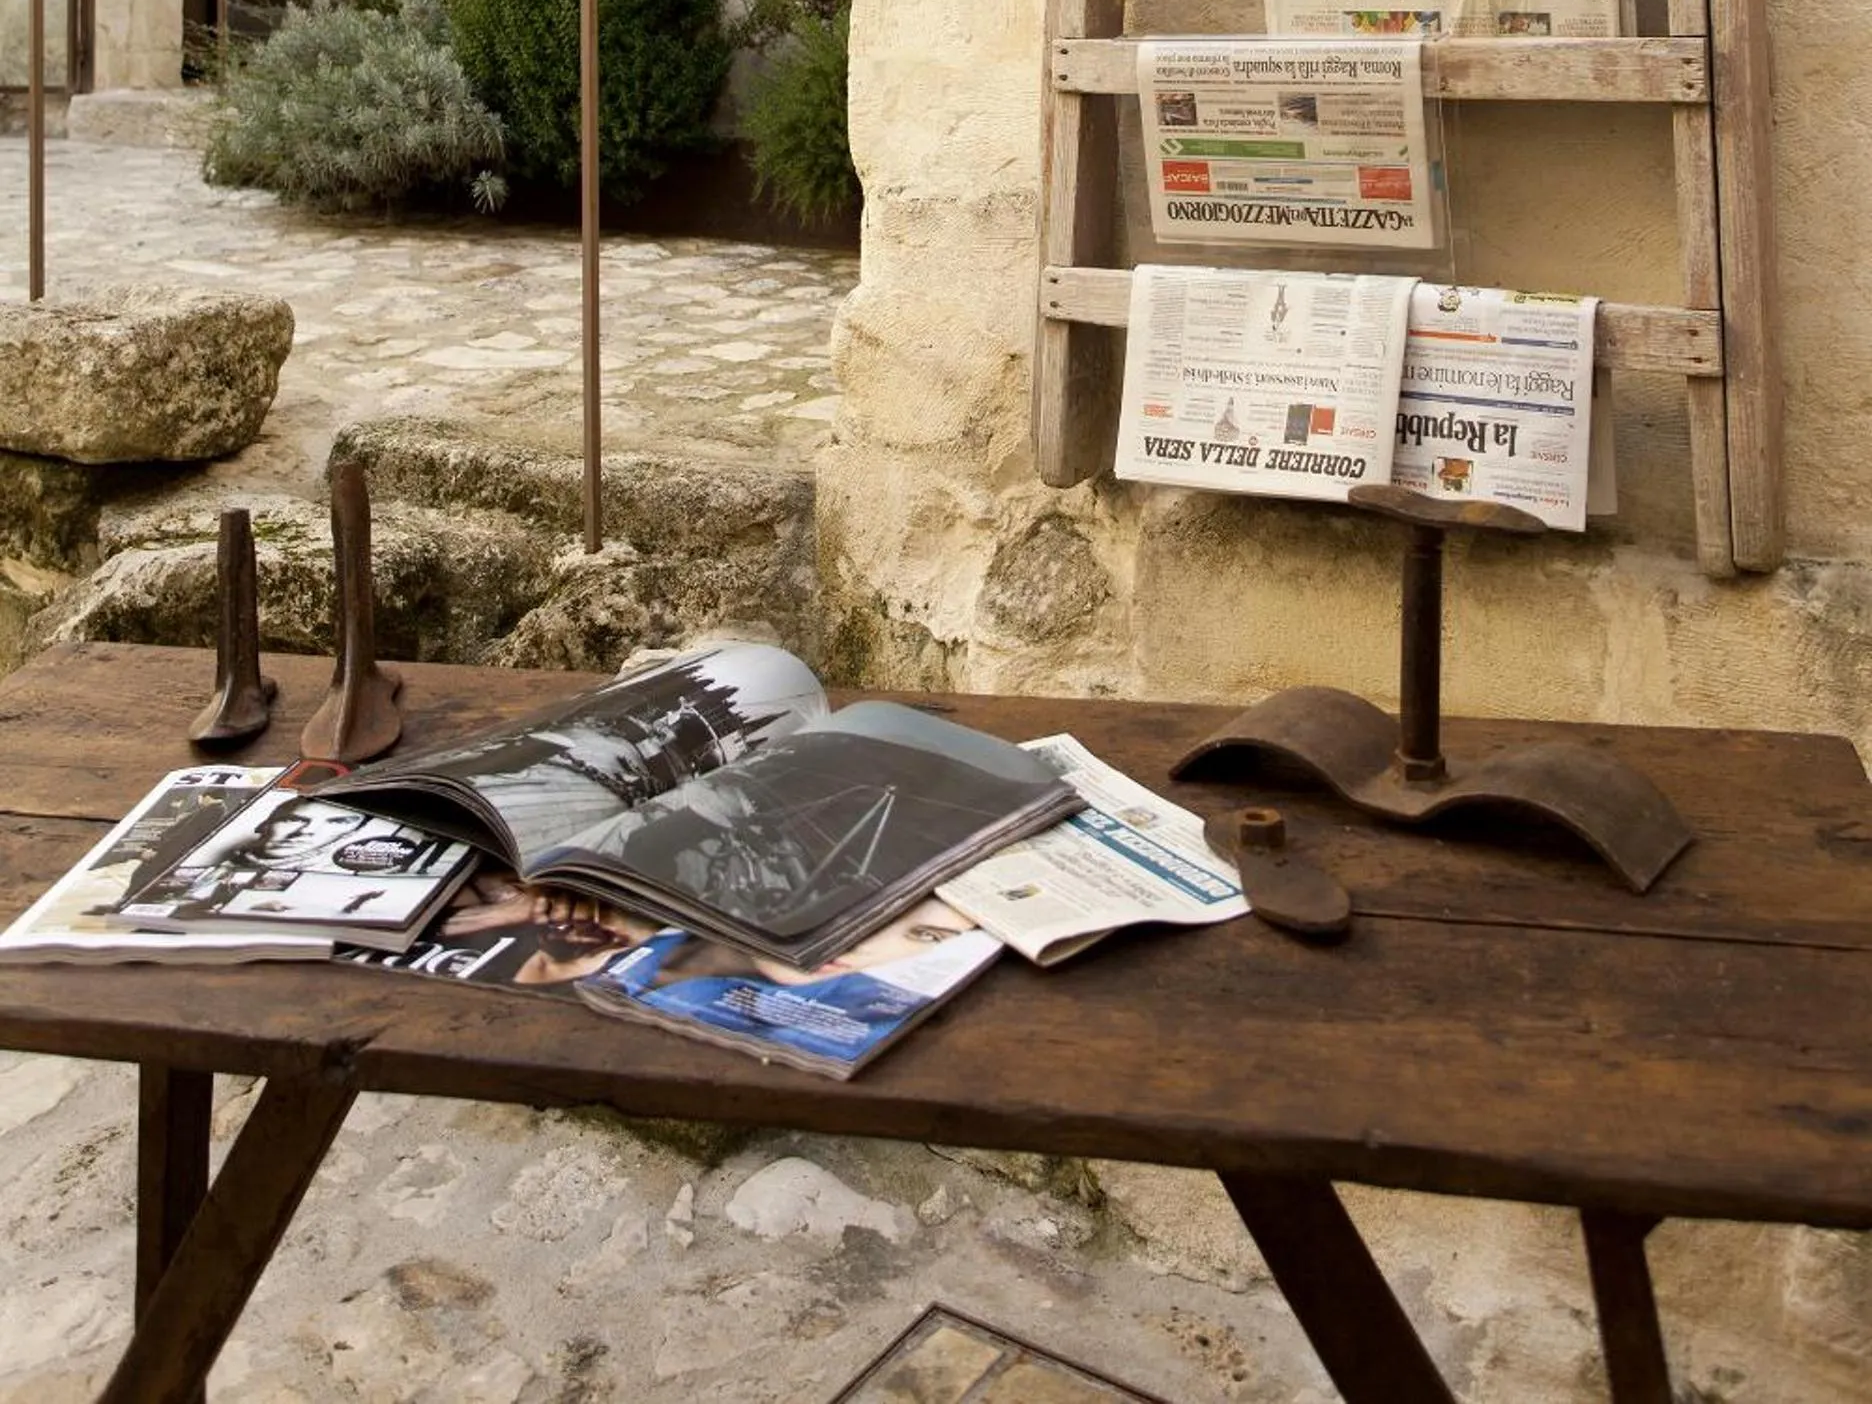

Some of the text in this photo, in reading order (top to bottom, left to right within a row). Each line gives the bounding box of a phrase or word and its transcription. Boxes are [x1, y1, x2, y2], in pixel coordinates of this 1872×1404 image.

[1233, 56, 1283, 77] squadra
[1283, 61, 1296, 78] la
[1322, 56, 1357, 78] Raggi
[1360, 60, 1401, 79] Roma,
[1167, 201, 1292, 225] MEZZOGIORNO
[1304, 207, 1402, 231] GAZZETTA
[1420, 366, 1485, 391] nomine
[1487, 373, 1503, 394] le
[1505, 376, 1521, 395] fa
[1524, 371, 1574, 402] Raggi
[1493, 423, 1518, 457] la
[1143, 436, 1366, 479] CORRIERE DELLA SERA
